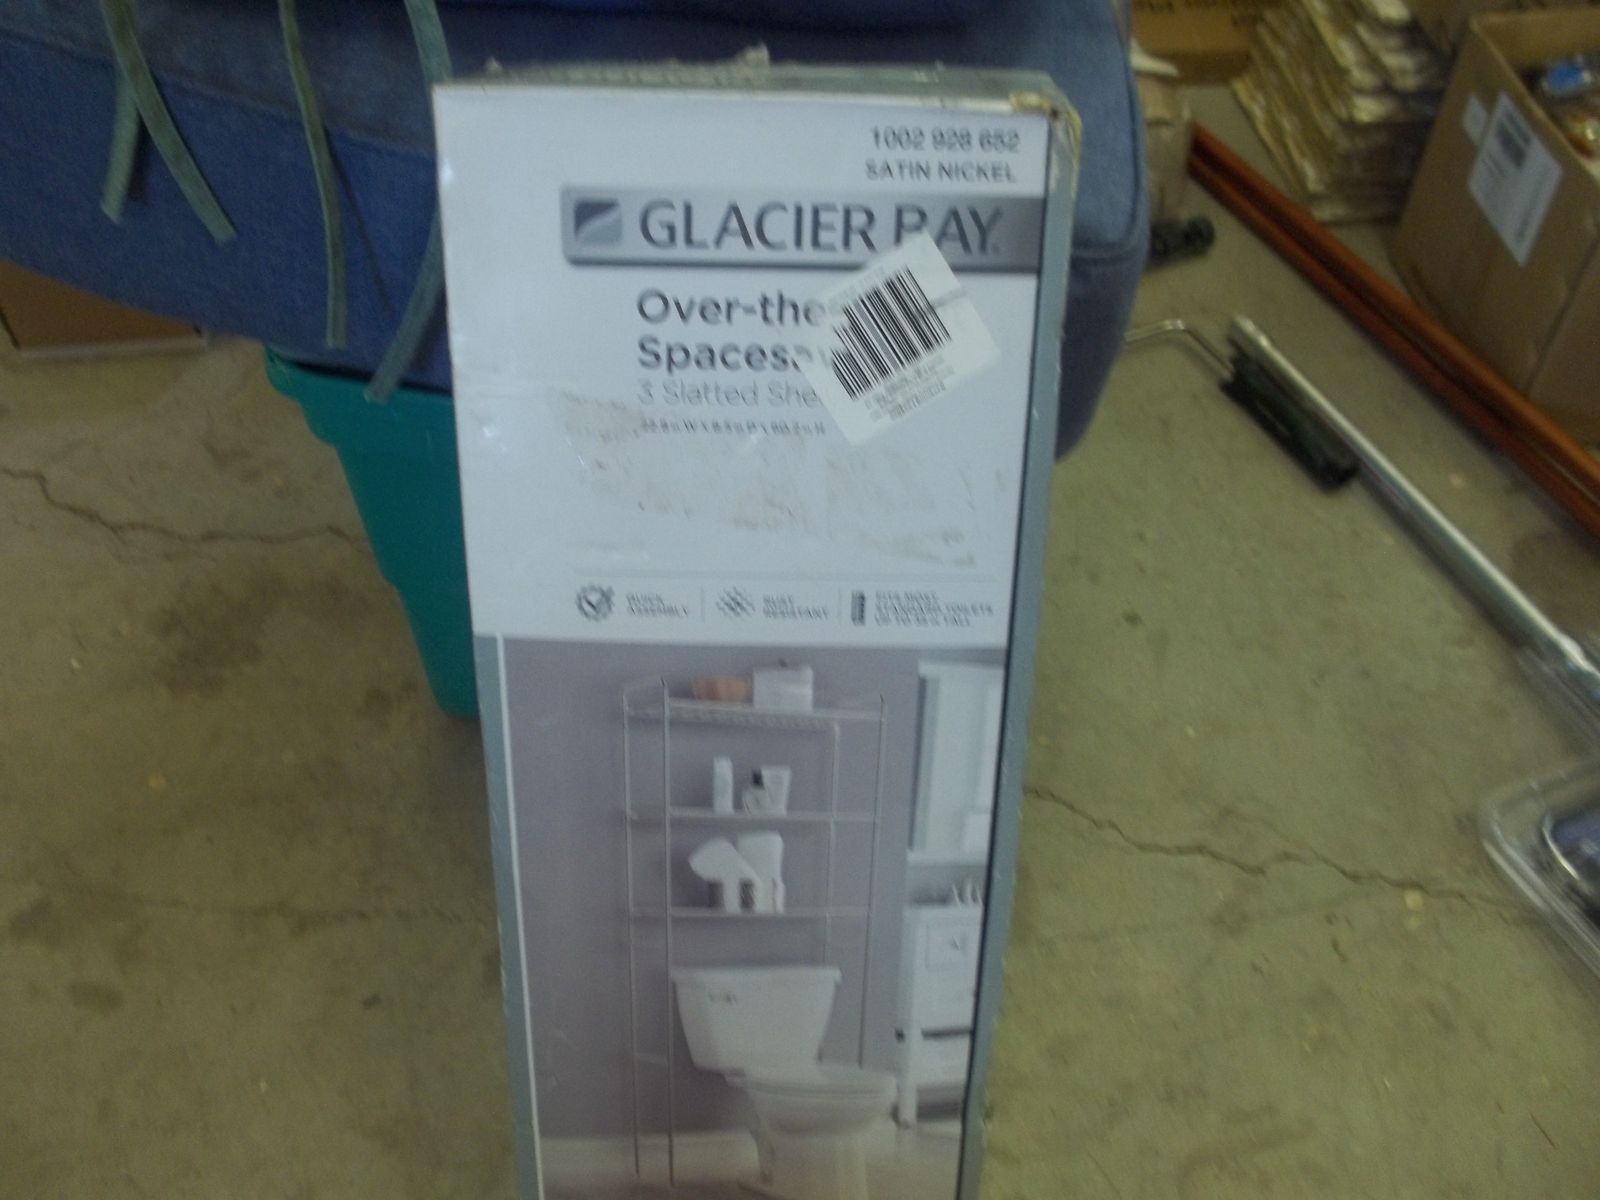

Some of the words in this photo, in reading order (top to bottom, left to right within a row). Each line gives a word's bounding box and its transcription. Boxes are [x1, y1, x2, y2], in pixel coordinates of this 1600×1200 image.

[873, 126, 925, 151] 1002
[931, 127, 972, 152] 928
[979, 128, 1020, 153] 652
[865, 158, 931, 182] SATIN
[938, 160, 1016, 184] NICKEL
[639, 200, 877, 252] GLACIER
[637, 287, 826, 326] Over-the
[637, 378, 654, 405] 3
[662, 379, 759, 406] Slatted
[767, 380, 820, 408] She
